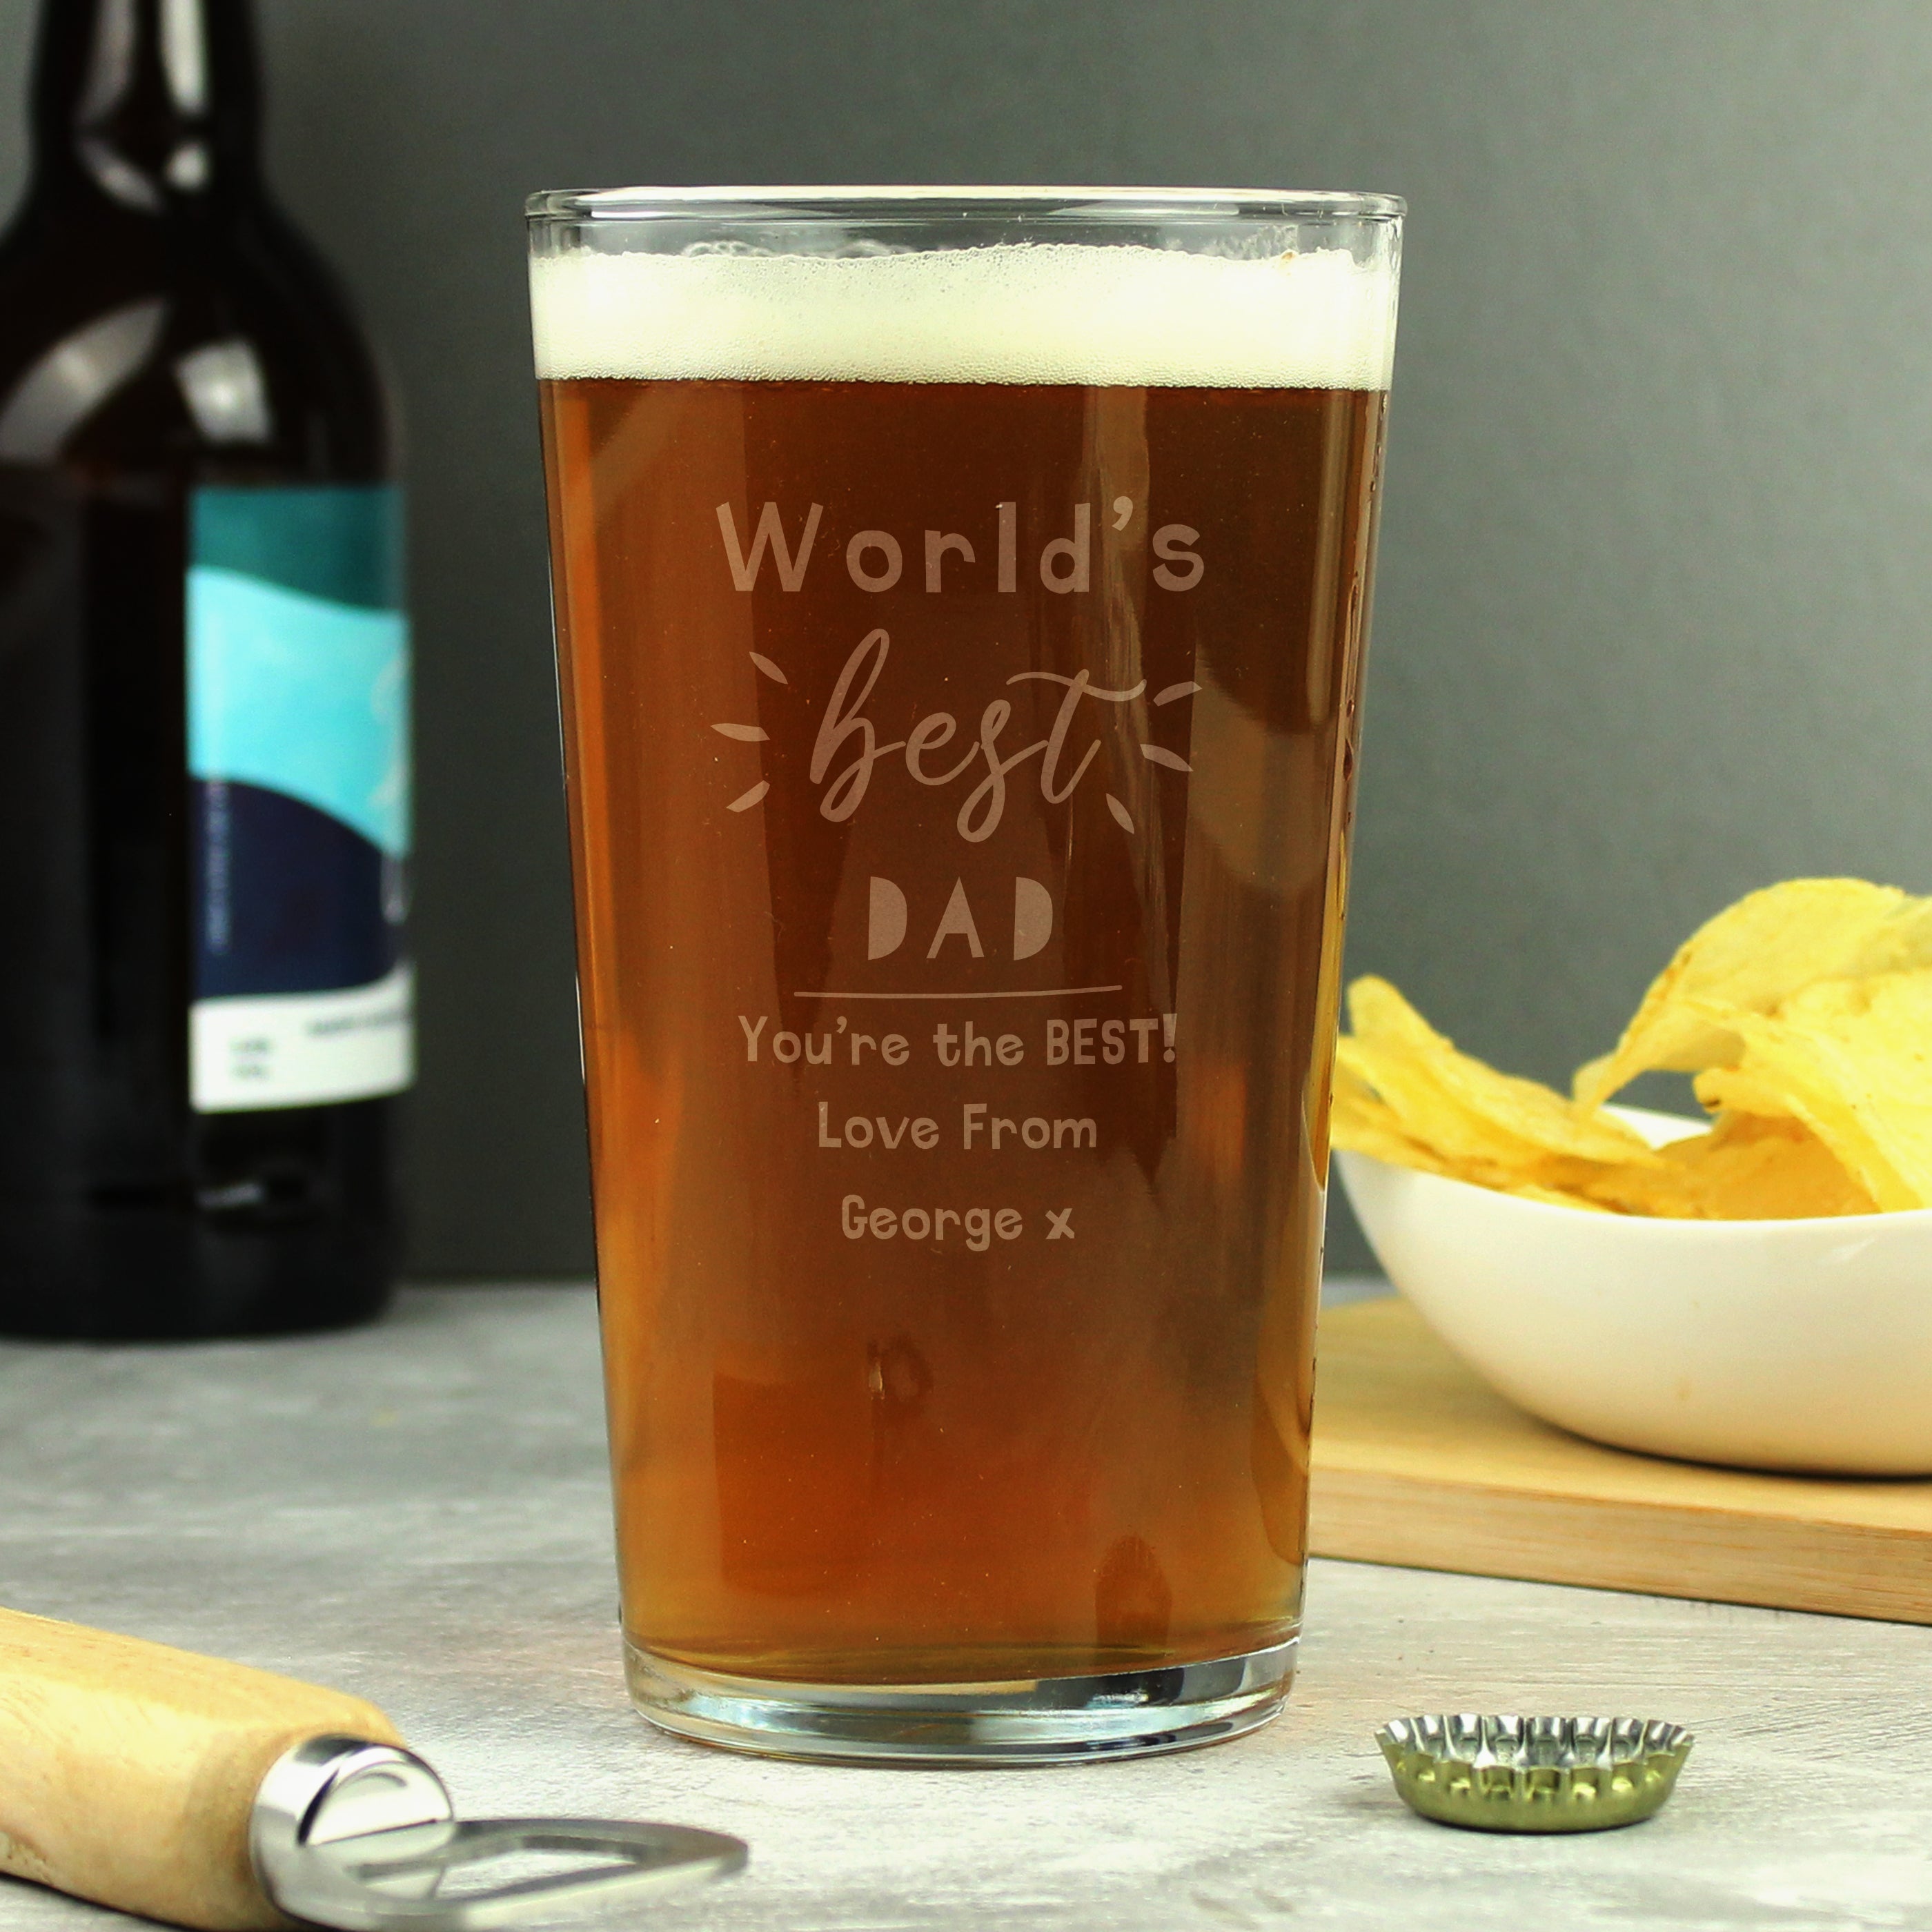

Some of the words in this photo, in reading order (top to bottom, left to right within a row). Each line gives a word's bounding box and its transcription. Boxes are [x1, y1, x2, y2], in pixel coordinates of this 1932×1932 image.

[809, 628, 1147, 843] best
[867, 876, 1054, 960] DAD
[933, 1021, 1025, 1067] the
[1046, 1013, 1178, 1065] BEST!
[818, 1101, 940, 1150] Love
[963, 1103, 1098, 1150] From
[840, 1194, 1023, 1252] George
[1045, 1208, 1075, 1240] x
